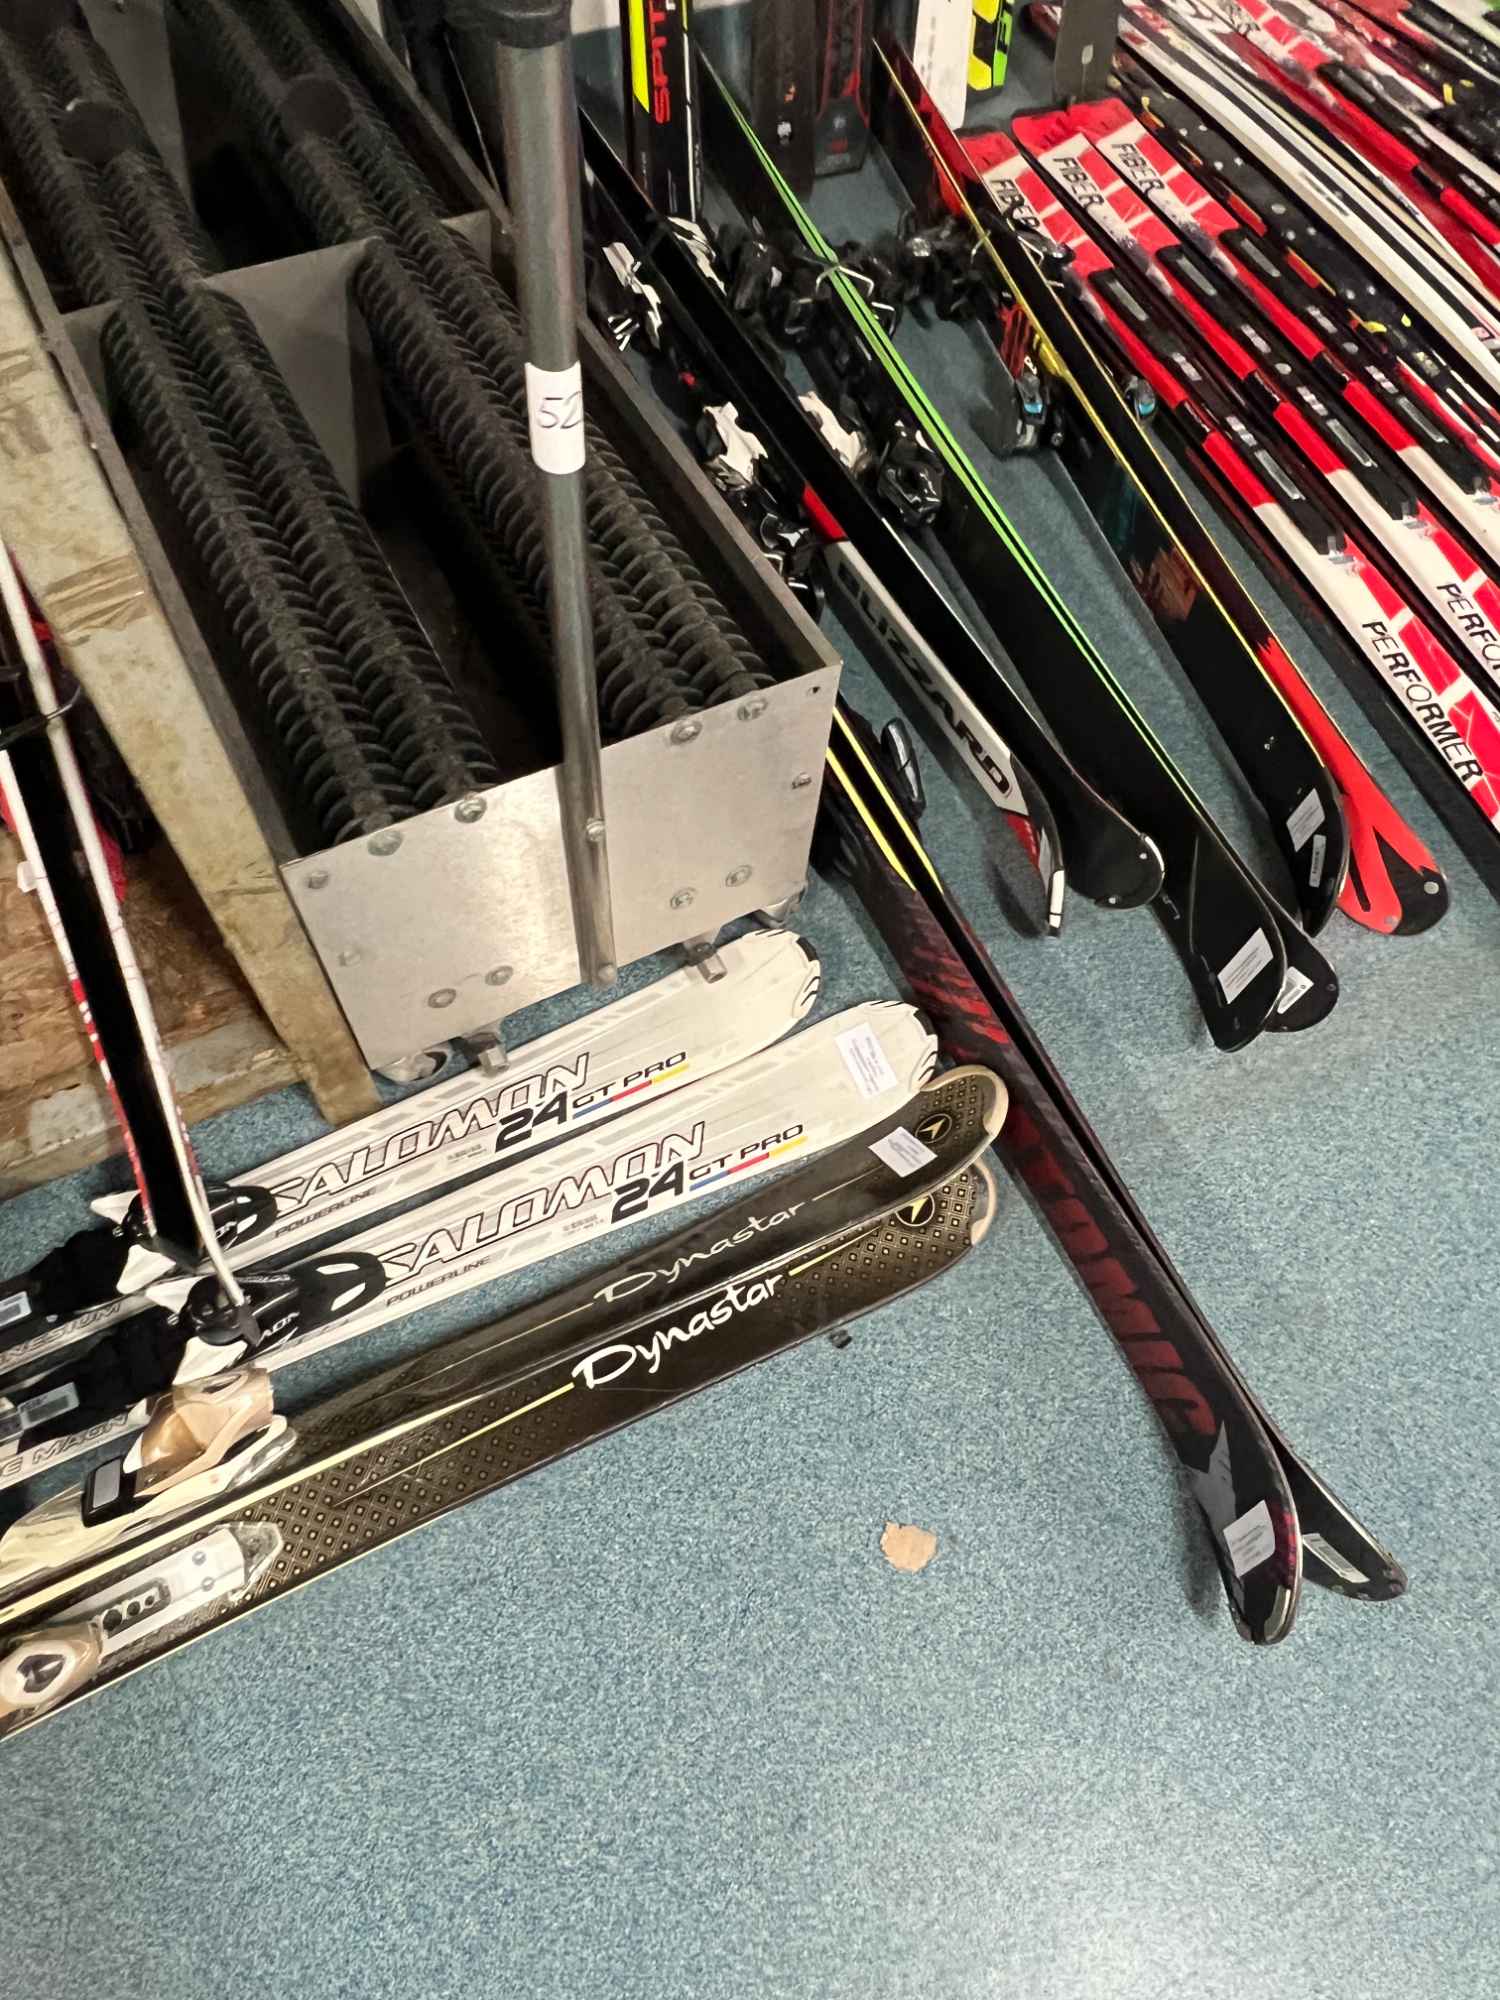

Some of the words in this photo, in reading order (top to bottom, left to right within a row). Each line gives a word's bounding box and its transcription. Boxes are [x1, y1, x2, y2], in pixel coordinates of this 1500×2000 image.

[1053, 156, 1106, 211] FIBER
[1111, 142, 1166, 196] FIBER
[537, 390, 583, 430] 52
[1436, 582, 1500, 672] PERFO
[838, 562, 1013, 795] BLIZZARD
[1362, 620, 1484, 784] PERFORMER
[267, 1051, 590, 1219] SALOMON
[495, 1090, 567, 1153] 24
[572, 1081, 617, 1110] GT
[623, 1051, 687, 1088] PRO
[275, 1187, 378, 1239] POWERLINE
[383, 1120, 705, 1290] SALOMON
[612, 1159, 684, 1224] 24
[688, 1153, 734, 1182] GT
[740, 1124, 804, 1160] PRO
[386, 1255, 491, 1307] POWERLINE
[593, 1201, 806, 1303] Dynastar
[571, 1274, 784, 1390] Dynastar
